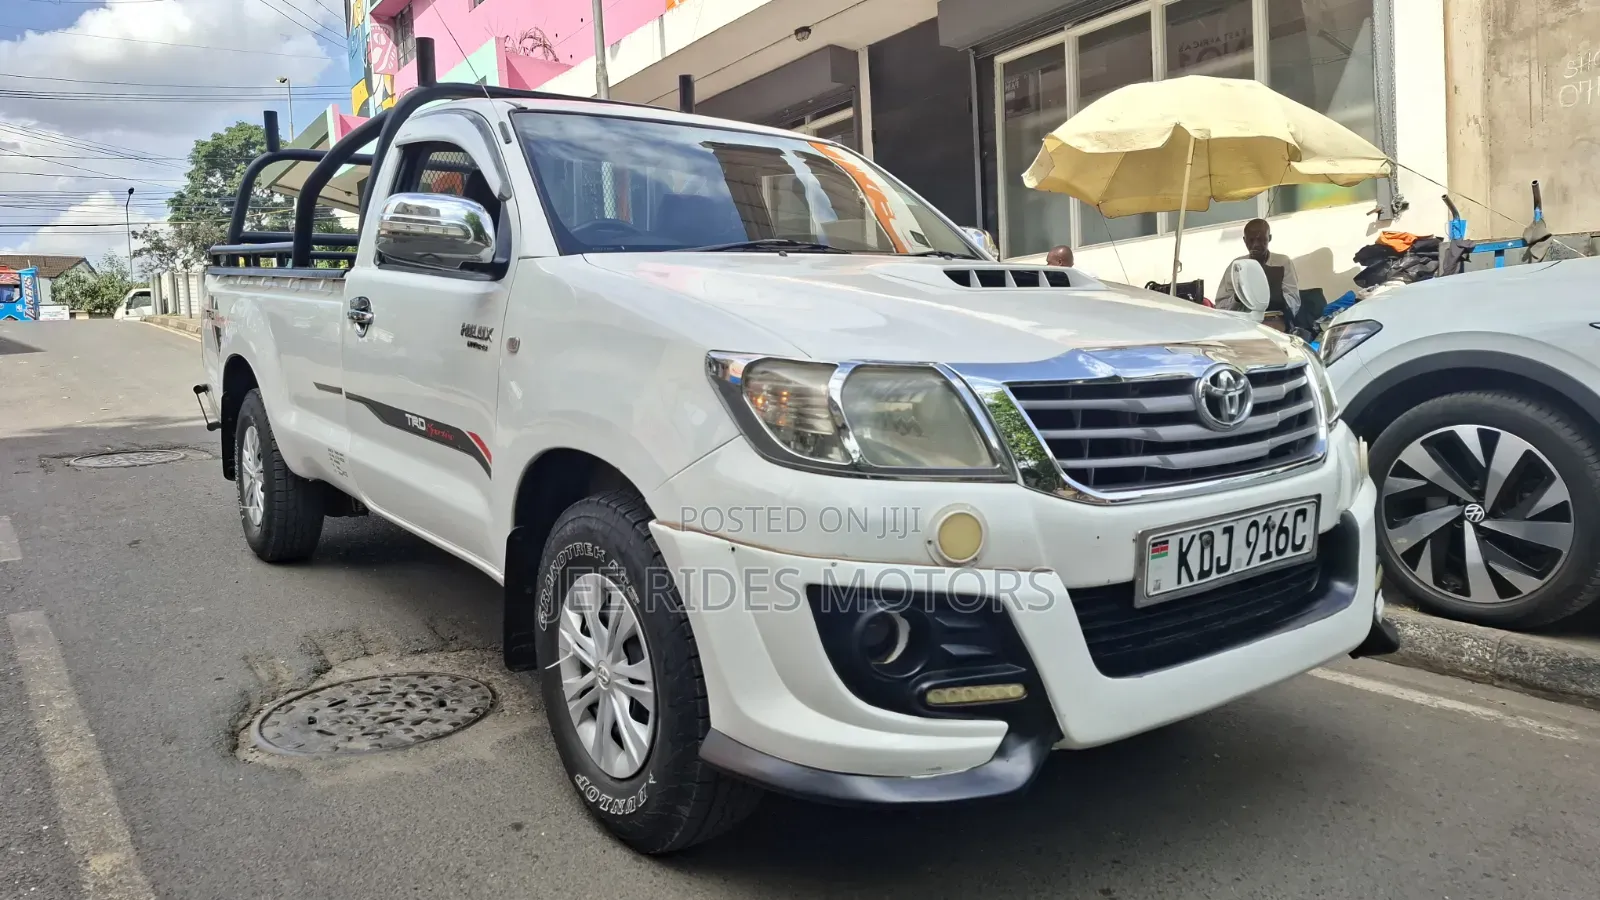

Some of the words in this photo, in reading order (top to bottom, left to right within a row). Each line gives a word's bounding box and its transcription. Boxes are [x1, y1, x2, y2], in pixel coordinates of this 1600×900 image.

[405, 413, 426, 431] TRD
[1177, 525, 1234, 585] KDJ
[1246, 508, 1307, 567] 916C
[575, 774, 649, 814] DUNLOP
